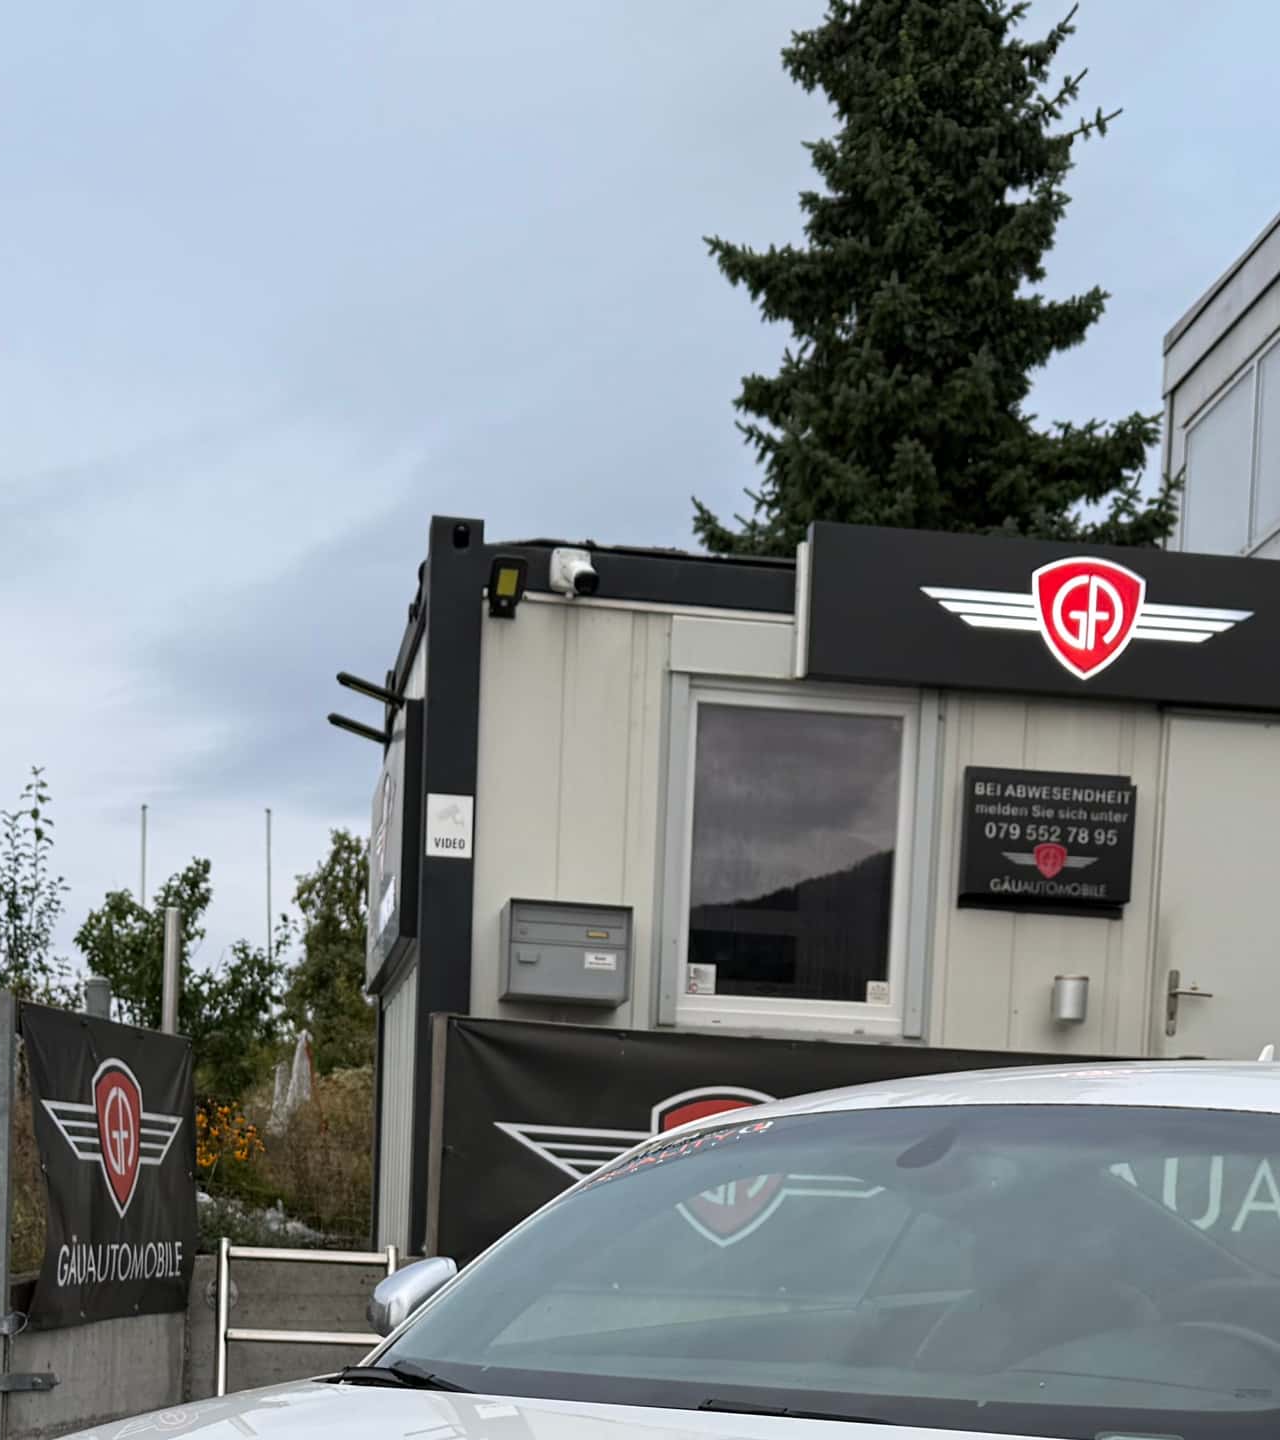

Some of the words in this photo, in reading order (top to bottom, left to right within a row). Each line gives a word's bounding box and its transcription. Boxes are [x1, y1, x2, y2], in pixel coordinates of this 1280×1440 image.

[974, 782, 1001, 796] BEI
[1004, 784, 1133, 805] ABWESENDHEIT
[975, 803, 1028, 817] melden
[1031, 804, 1057, 818] Sie
[1058, 806, 1088, 821] sich
[1090, 809, 1129, 823] unter
[434, 837, 466, 850] VIDEO
[984, 822, 1021, 839] 079
[1025, 825, 1061, 842] 552
[1067, 827, 1089, 844] 78
[1094, 829, 1119, 846] 95
[989, 876, 1107, 897] GÄUAUTOMOBILE
[57, 1235, 183, 1287] GÄUAUTOMOBILE
